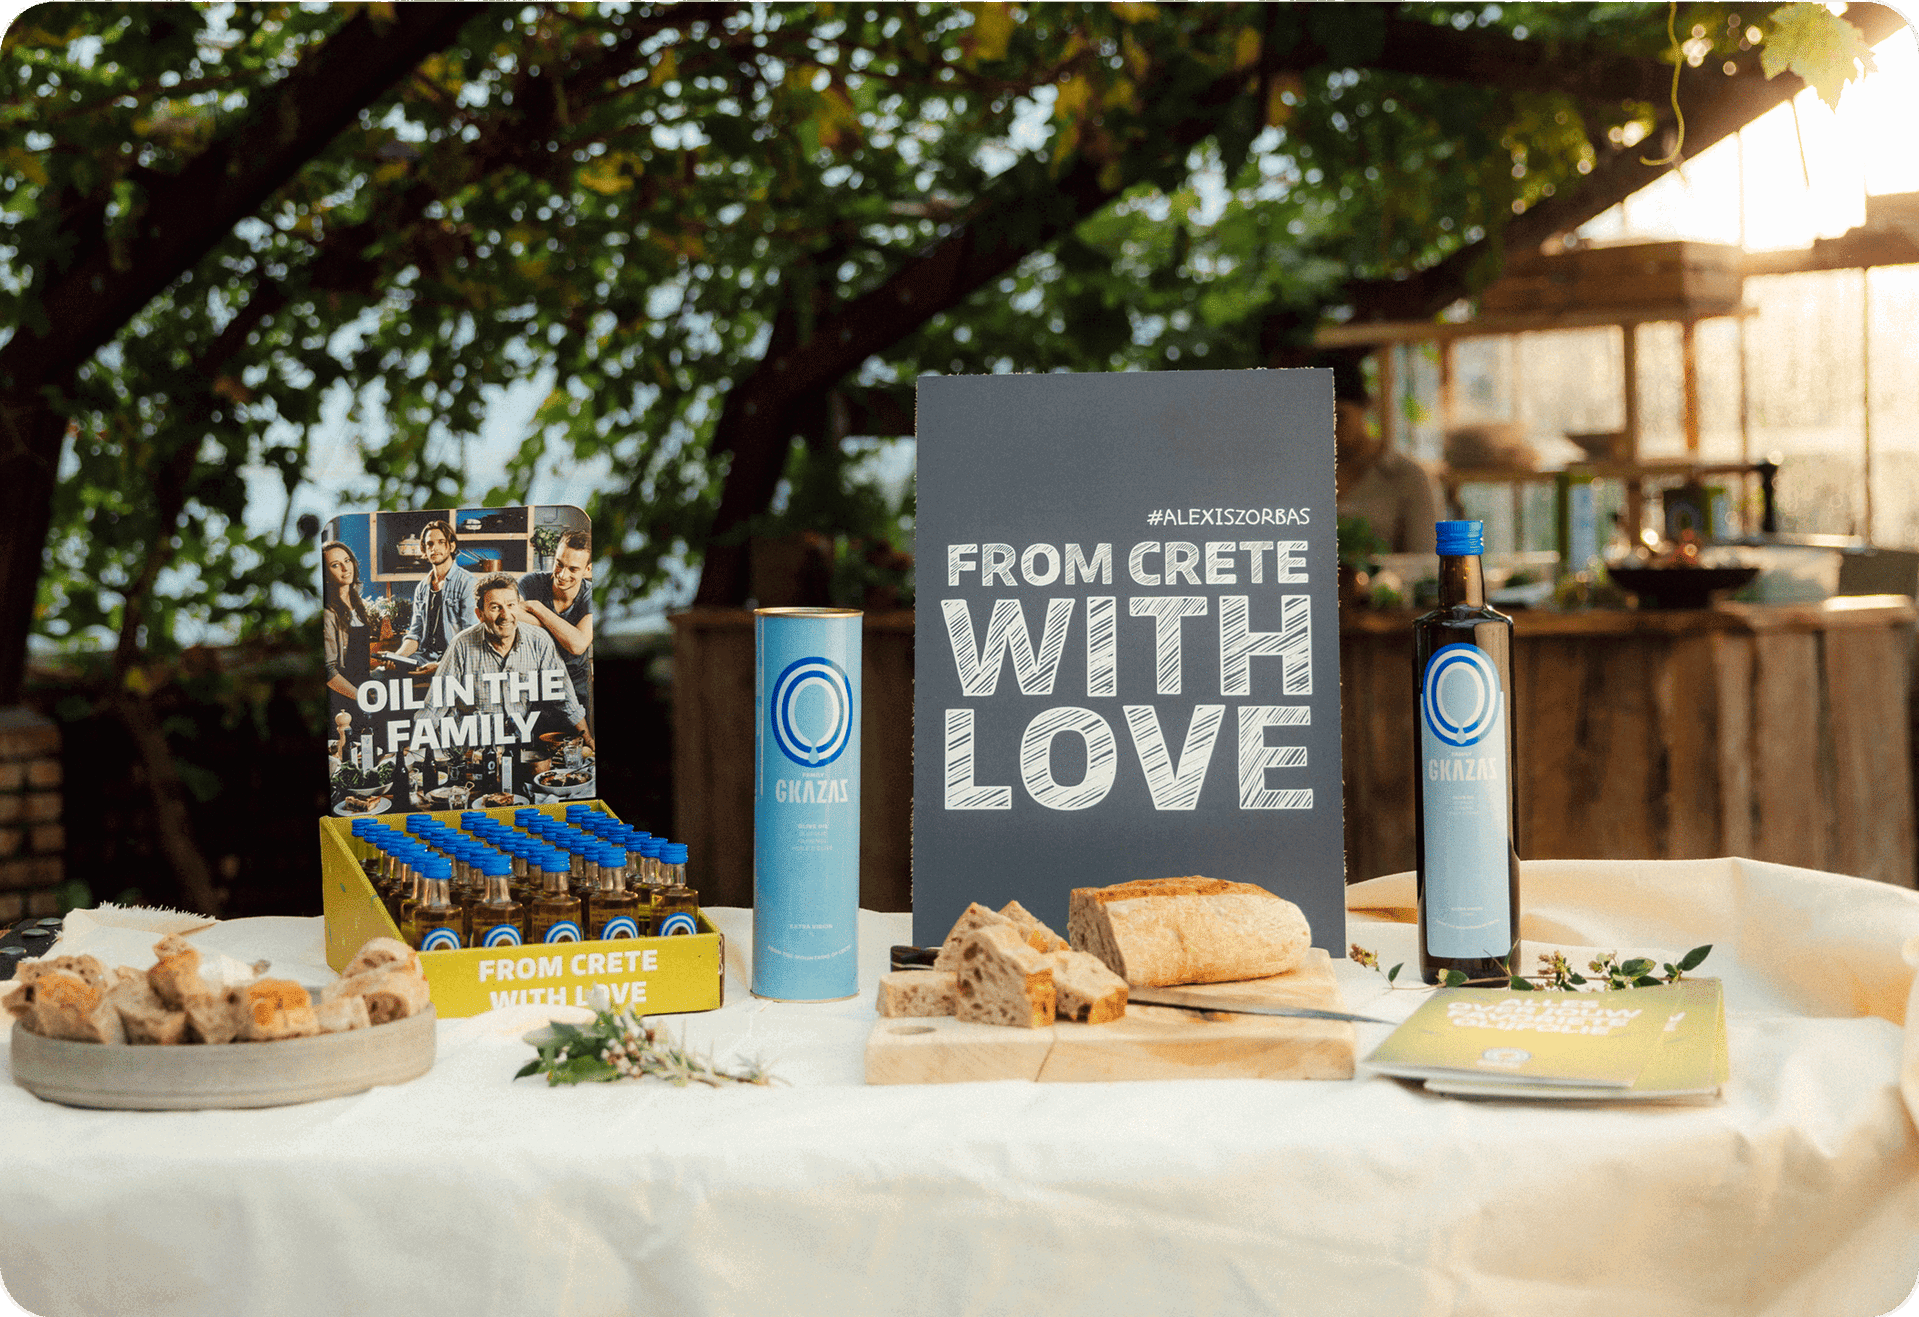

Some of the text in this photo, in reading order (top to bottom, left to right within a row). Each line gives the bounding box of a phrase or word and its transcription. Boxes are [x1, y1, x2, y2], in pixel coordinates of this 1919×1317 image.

[1147, 508, 1311, 526] #ALEXISZORBAS
[947, 540, 1310, 587] FROM CRETE
[940, 594, 1313, 697] WITH
[356, 669, 567, 713] OIL IN THE
[387, 711, 541, 753] FAMILY
[944, 704, 1313, 811] LOVE
[478, 949, 658, 983] FROM CRETE
[489, 986, 567, 1010] WITH
